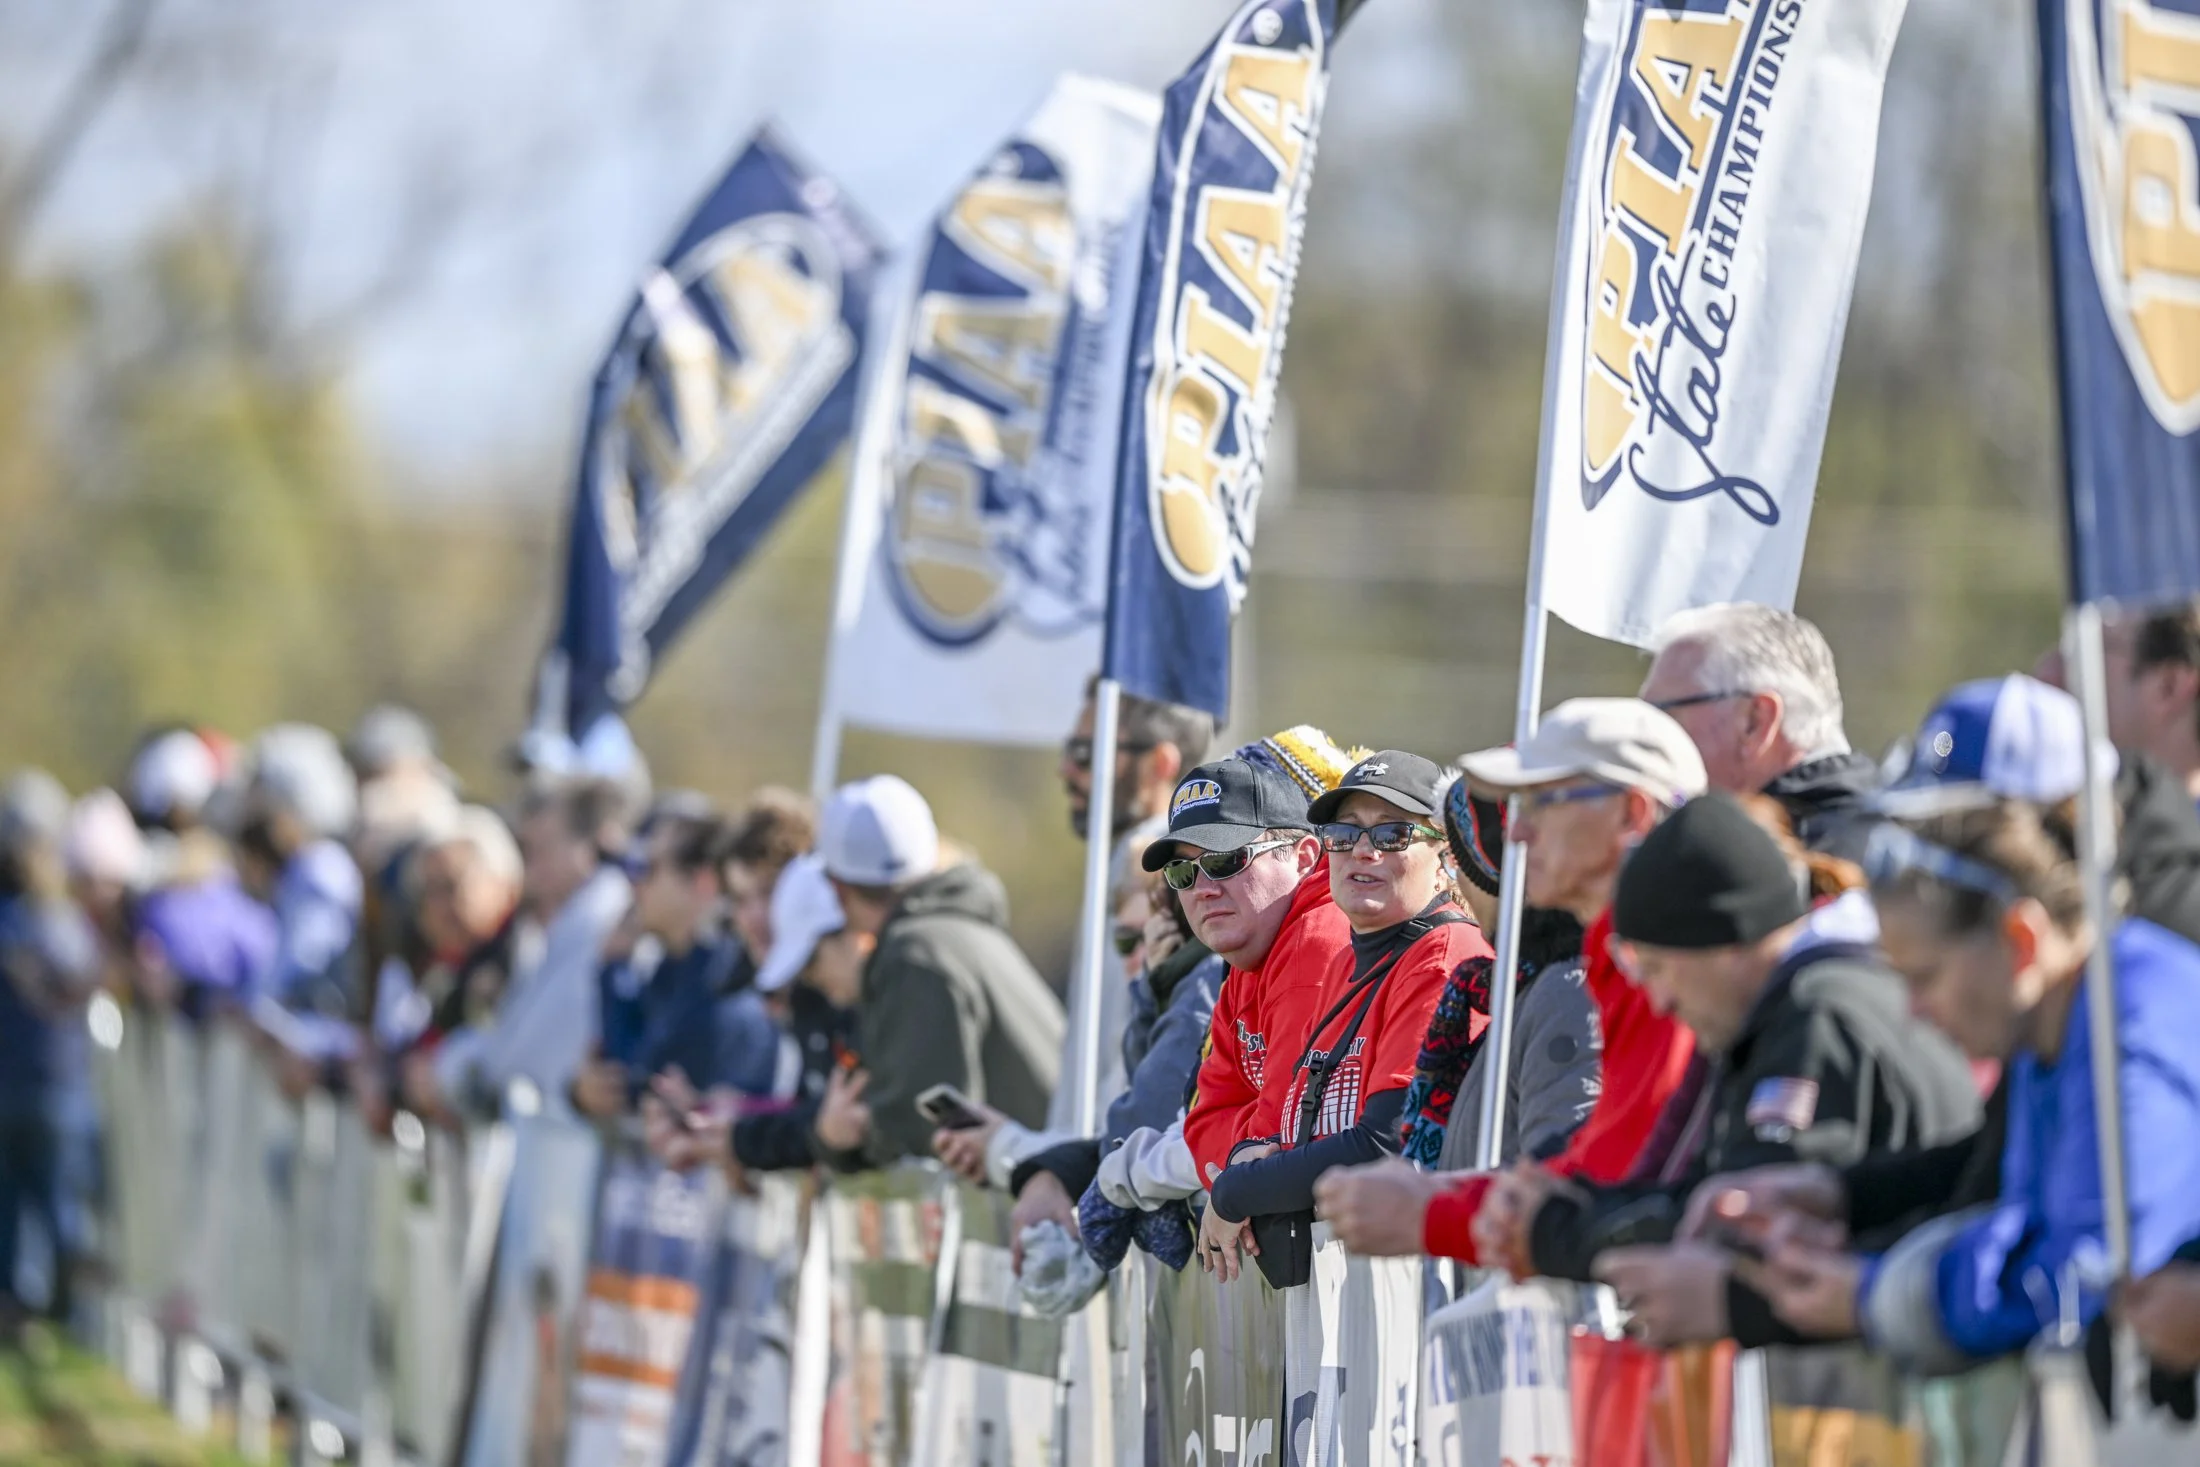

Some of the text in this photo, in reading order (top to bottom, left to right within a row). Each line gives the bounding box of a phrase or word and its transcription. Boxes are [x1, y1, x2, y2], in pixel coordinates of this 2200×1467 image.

[1158, 44, 1316, 500] PIAA
[1588, 0, 1752, 408] PIA
[1628, 0, 1807, 527] State CHAMPIONS
[1174, 782, 1216, 807] PIAA
